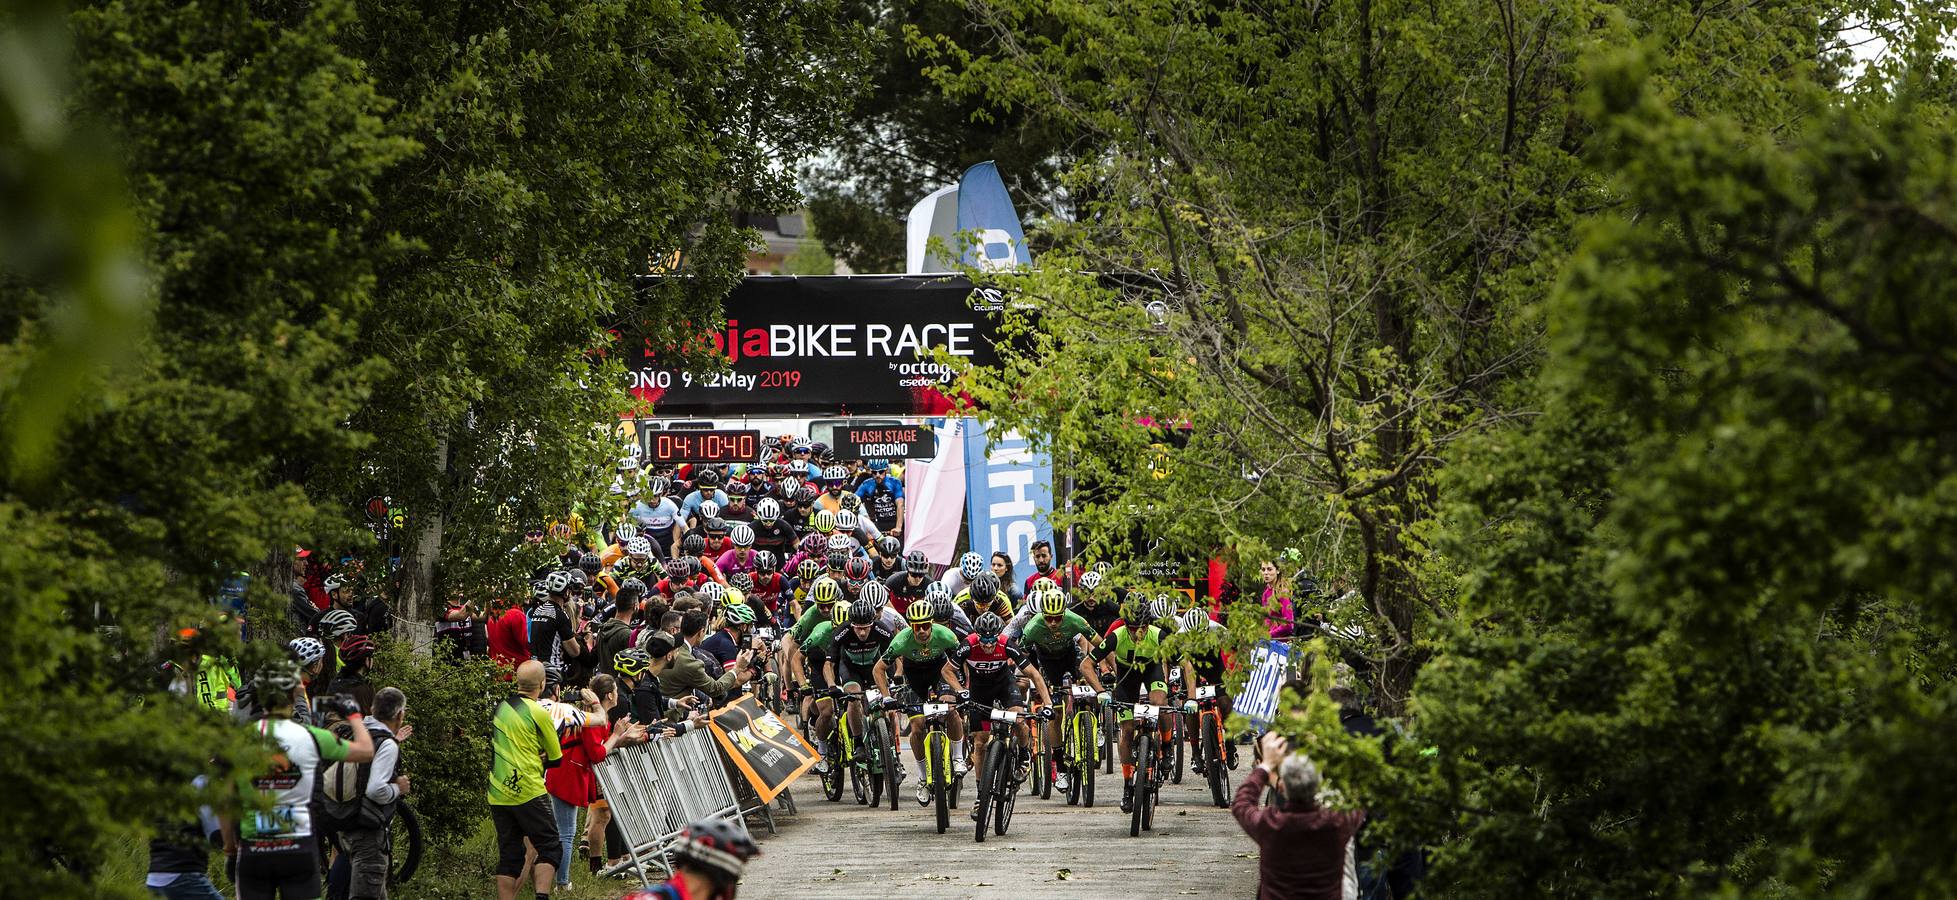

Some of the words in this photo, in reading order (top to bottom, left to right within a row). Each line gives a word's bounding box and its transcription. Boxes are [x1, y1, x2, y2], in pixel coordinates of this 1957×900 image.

[866, 323, 974, 357] RACE
[889, 362, 898, 371] by
[760, 370, 801, 388] 2019
[850, 431, 882, 443] FLASH
[885, 429, 917, 442] STAGE
[658, 435, 753, 459] 04:10:40
[860, 440, 908, 456] LOGROÑO
[1171, 669, 1178, 677] 6
[1200, 687, 1206, 696] 3
[1143, 705, 1150, 714] 2
